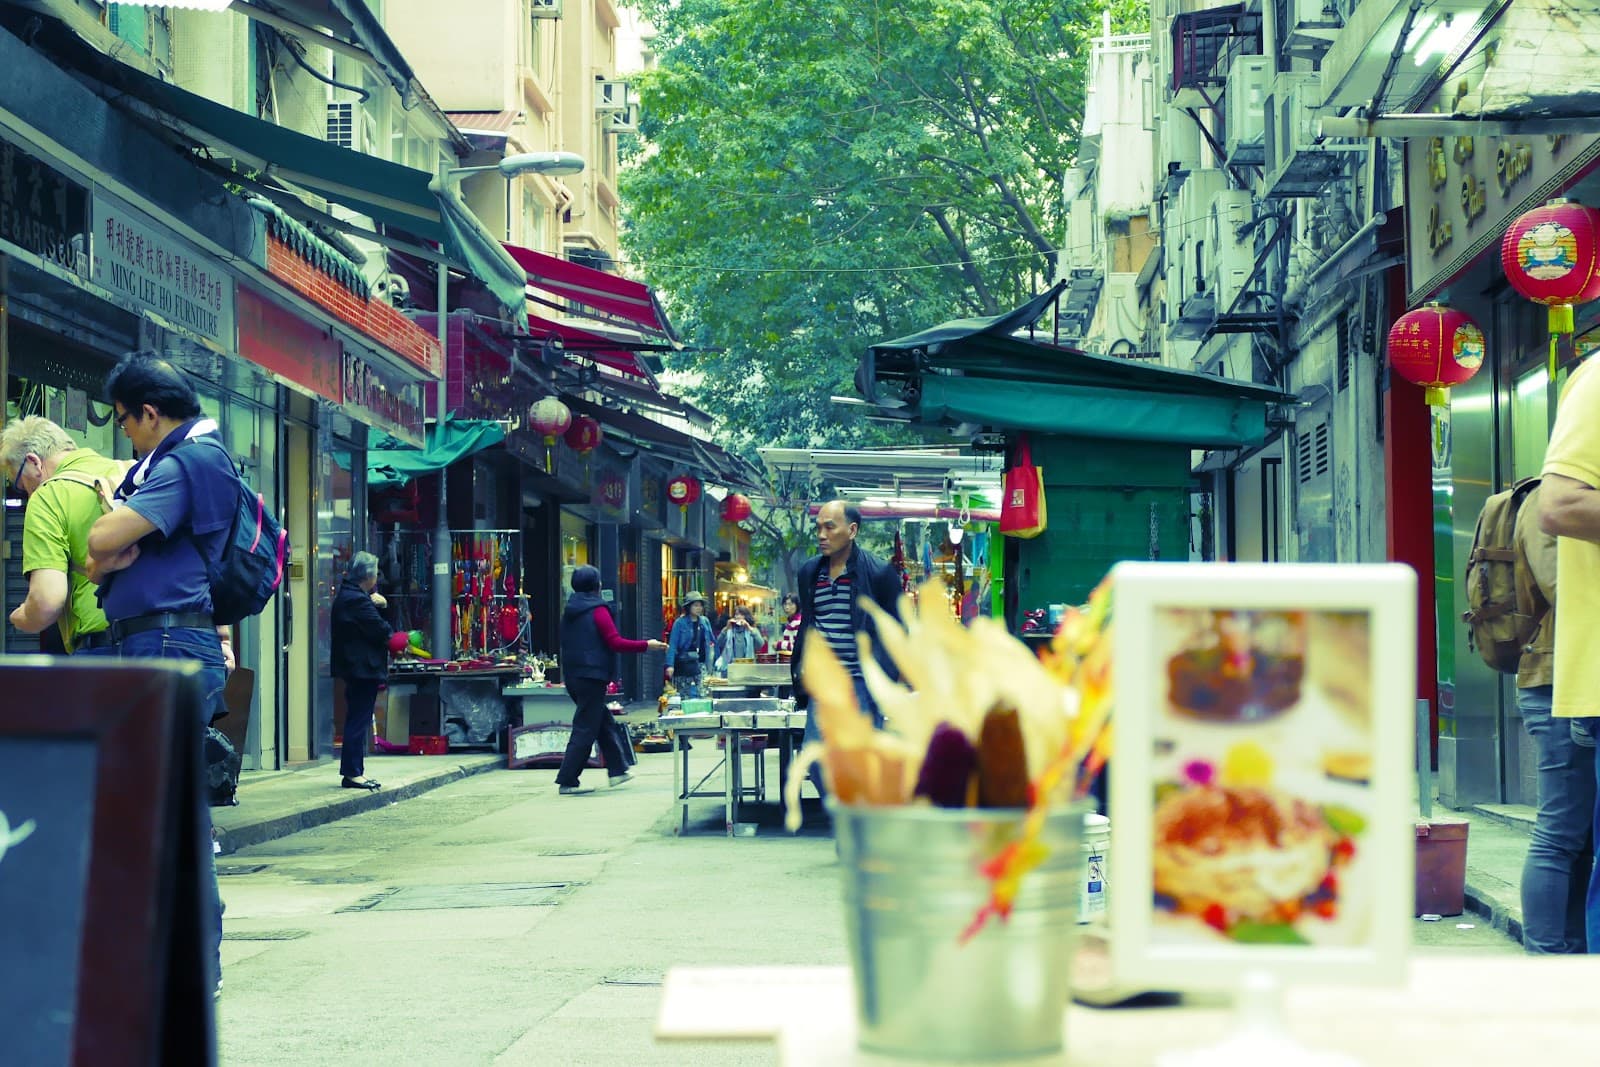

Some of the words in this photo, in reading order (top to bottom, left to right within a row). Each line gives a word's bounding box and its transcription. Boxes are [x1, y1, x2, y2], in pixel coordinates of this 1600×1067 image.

[110, 260, 136, 296] MING
[139, 275, 156, 306] LEE
[159, 286, 172, 313] HO
[175, 294, 218, 338] FURNITURE
